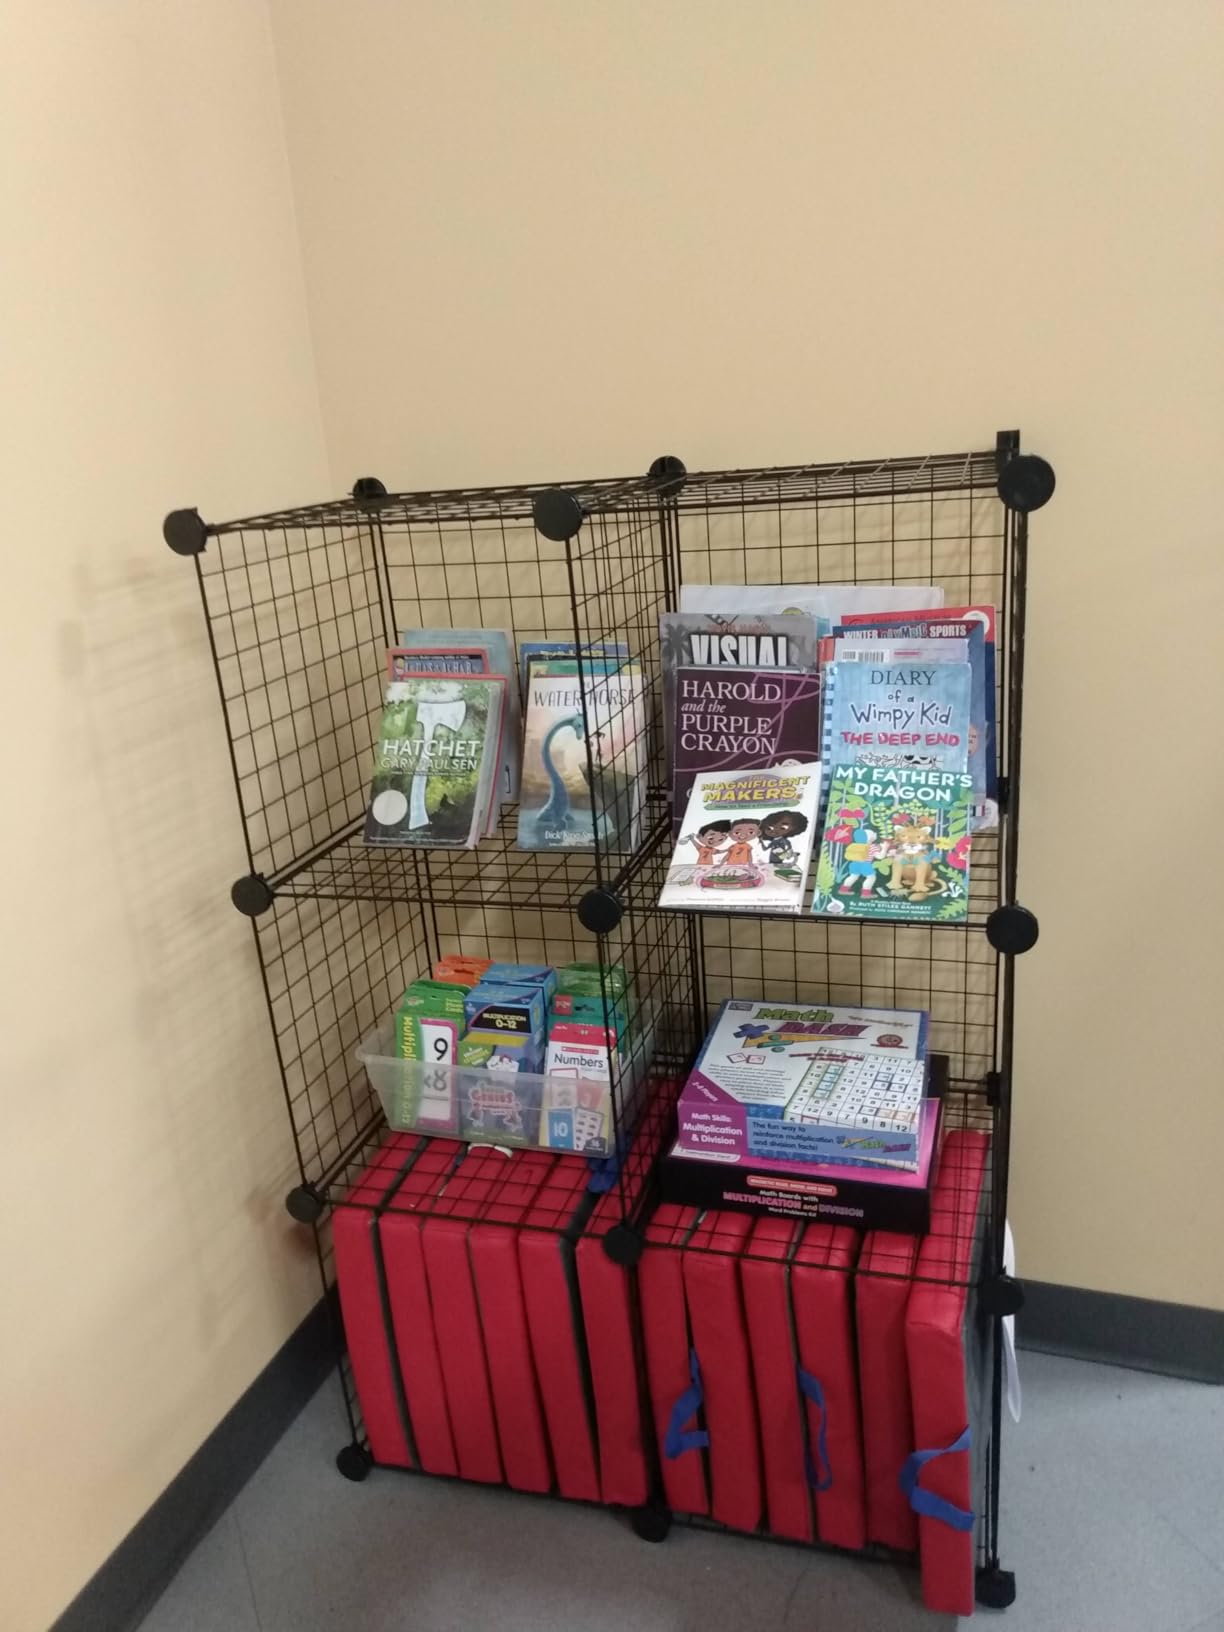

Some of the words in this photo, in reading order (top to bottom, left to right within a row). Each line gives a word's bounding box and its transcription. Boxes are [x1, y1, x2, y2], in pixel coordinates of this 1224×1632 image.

[843, 630, 878, 639] WINTER
[930, 624, 967, 638] SPORTS
[870, 670, 937, 686] DIARY
[682, 680, 782, 701] HAROLD
[888, 690, 902, 703] of
[534, 690, 581, 707] WATER
[680, 699, 704, 712] and
[708, 700, 726, 714] the
[850, 704, 915, 730] Wimpy
[920, 702, 952, 726] Kid
[681, 714, 772, 736] PURPLE
[680, 732, 776, 755] CRAYON
[841, 732, 874, 745] THE
[878, 732, 921, 746] DEEP
[925, 732, 960, 747] END
[383, 739, 481, 758] HATCHET
[380, 756, 416, 770] GARY
[701, 775, 811, 791] MAGNIFICENT
[836, 766, 868, 780] MY
[872, 768, 973, 788] FATHER'S
[703, 786, 798, 802] MAKERS
[854, 782, 951, 802] DRAGON
[753, 1007, 834, 1022] Math
[495, 1020, 518, 1030] 0-12
[776, 1021, 872, 1036] DASH
[434, 1037, 448, 1061] 9
[554, 1053, 604, 1068] Numbers
[691, 1112, 711, 1120] Math
[553, 1121, 568, 1138] 10
[682, 1122, 743, 1136] Multiplication
[752, 1121, 766, 1129] The
[782, 1124, 798, 1133] way
[896, 1124, 908, 1132] 12
[691, 1133, 700, 1142] &
[700, 1134, 736, 1145] Division
[753, 1131, 784, 1140] reinforce
[786, 1133, 834, 1144] multiplication
[769, 1139, 796, 1148] division
[723, 1192, 802, 1210] MULTIPLICATION
[818, 1204, 864, 1218] DIVISION
